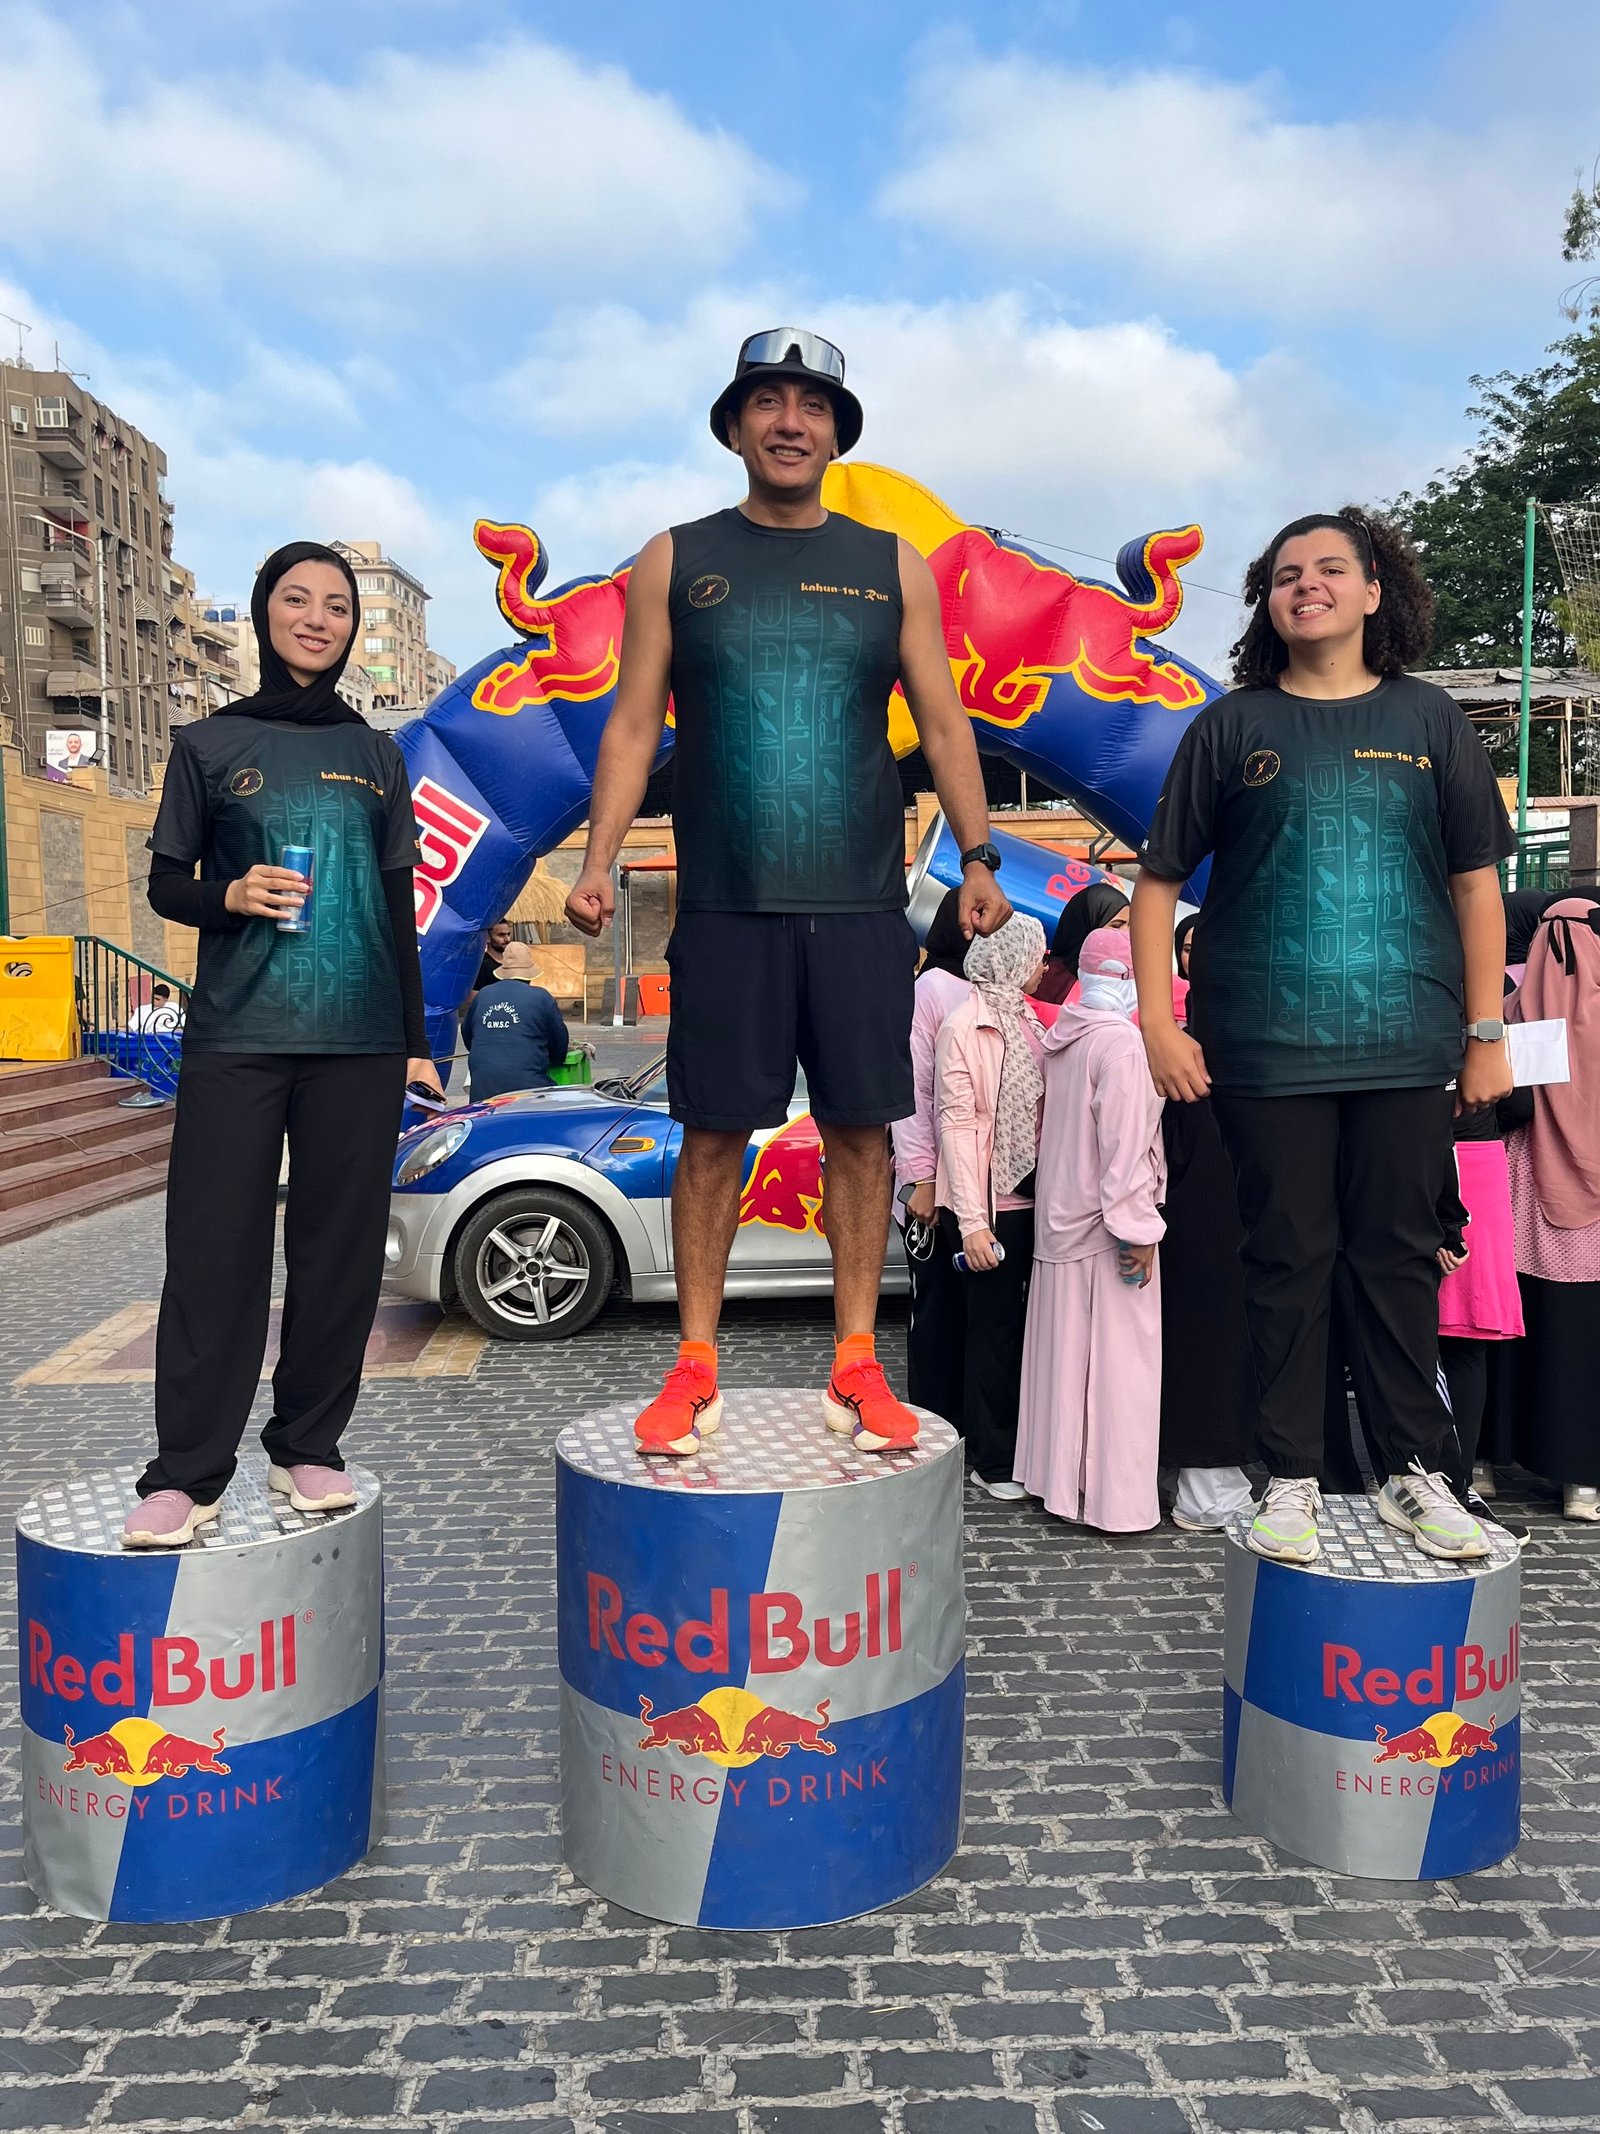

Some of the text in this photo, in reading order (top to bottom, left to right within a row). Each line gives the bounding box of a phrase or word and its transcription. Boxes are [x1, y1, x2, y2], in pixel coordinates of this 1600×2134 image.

[865, 589, 889, 602] Run
[413, 783, 483, 929] ull
[587, 1567, 903, 1675] Red Bull
[29, 1614, 298, 1707] Red Bull
[1323, 1621, 1520, 1706] Red Bull
[38, 1775, 285, 1820] ENERGY DRINK
[602, 1755, 890, 1807] ENERGY DRINK
[1335, 1752, 1516, 1797] ENERGY DRINK
